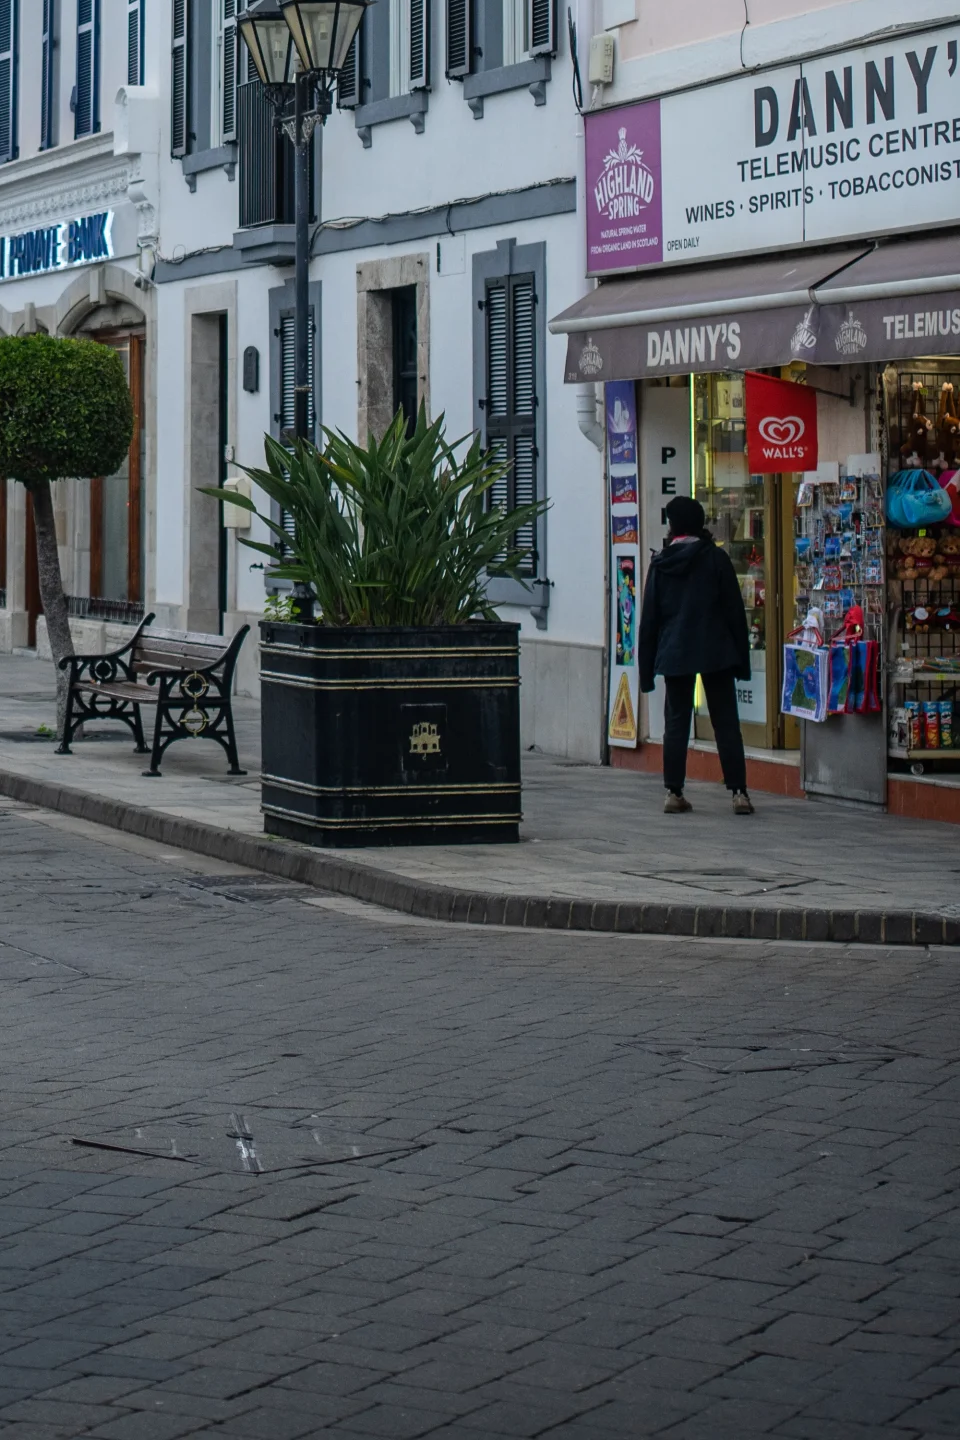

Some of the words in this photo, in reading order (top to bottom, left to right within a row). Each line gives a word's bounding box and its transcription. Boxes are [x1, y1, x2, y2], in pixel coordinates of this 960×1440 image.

[737, 138, 860, 182] TELEMUSIC
[868, 117, 960, 158] CENTRE
[594, 164, 654, 213] HIGHLAND
[685, 200, 735, 225] WINES
[748, 186, 814, 214] SPIRITS
[828, 160, 960, 200] TOBACCONIST
[608, 194, 640, 221] SPRING
[8, 224, 62, 277] PRIVATE
[67, 211, 111, 263] BANK
[600, 228, 618, 239] NATURAL
[618, 226, 633, 236] SPRING
[633, 224, 647, 234] WATER
[667, 240, 683, 251] OPEN
[684, 236, 700, 249] DAILY
[590, 246, 602, 255] FROM
[602, 243, 620, 253] ORGANIC
[620, 241, 632, 250] LAND
[636, 237, 659, 248] SCOTLAND
[646, 322, 741, 367] DANNY'S
[835, 326, 868, 352] HIGHLAND
[842, 343, 859, 355] SPRING
[762, 446, 805, 459] WALL'S
